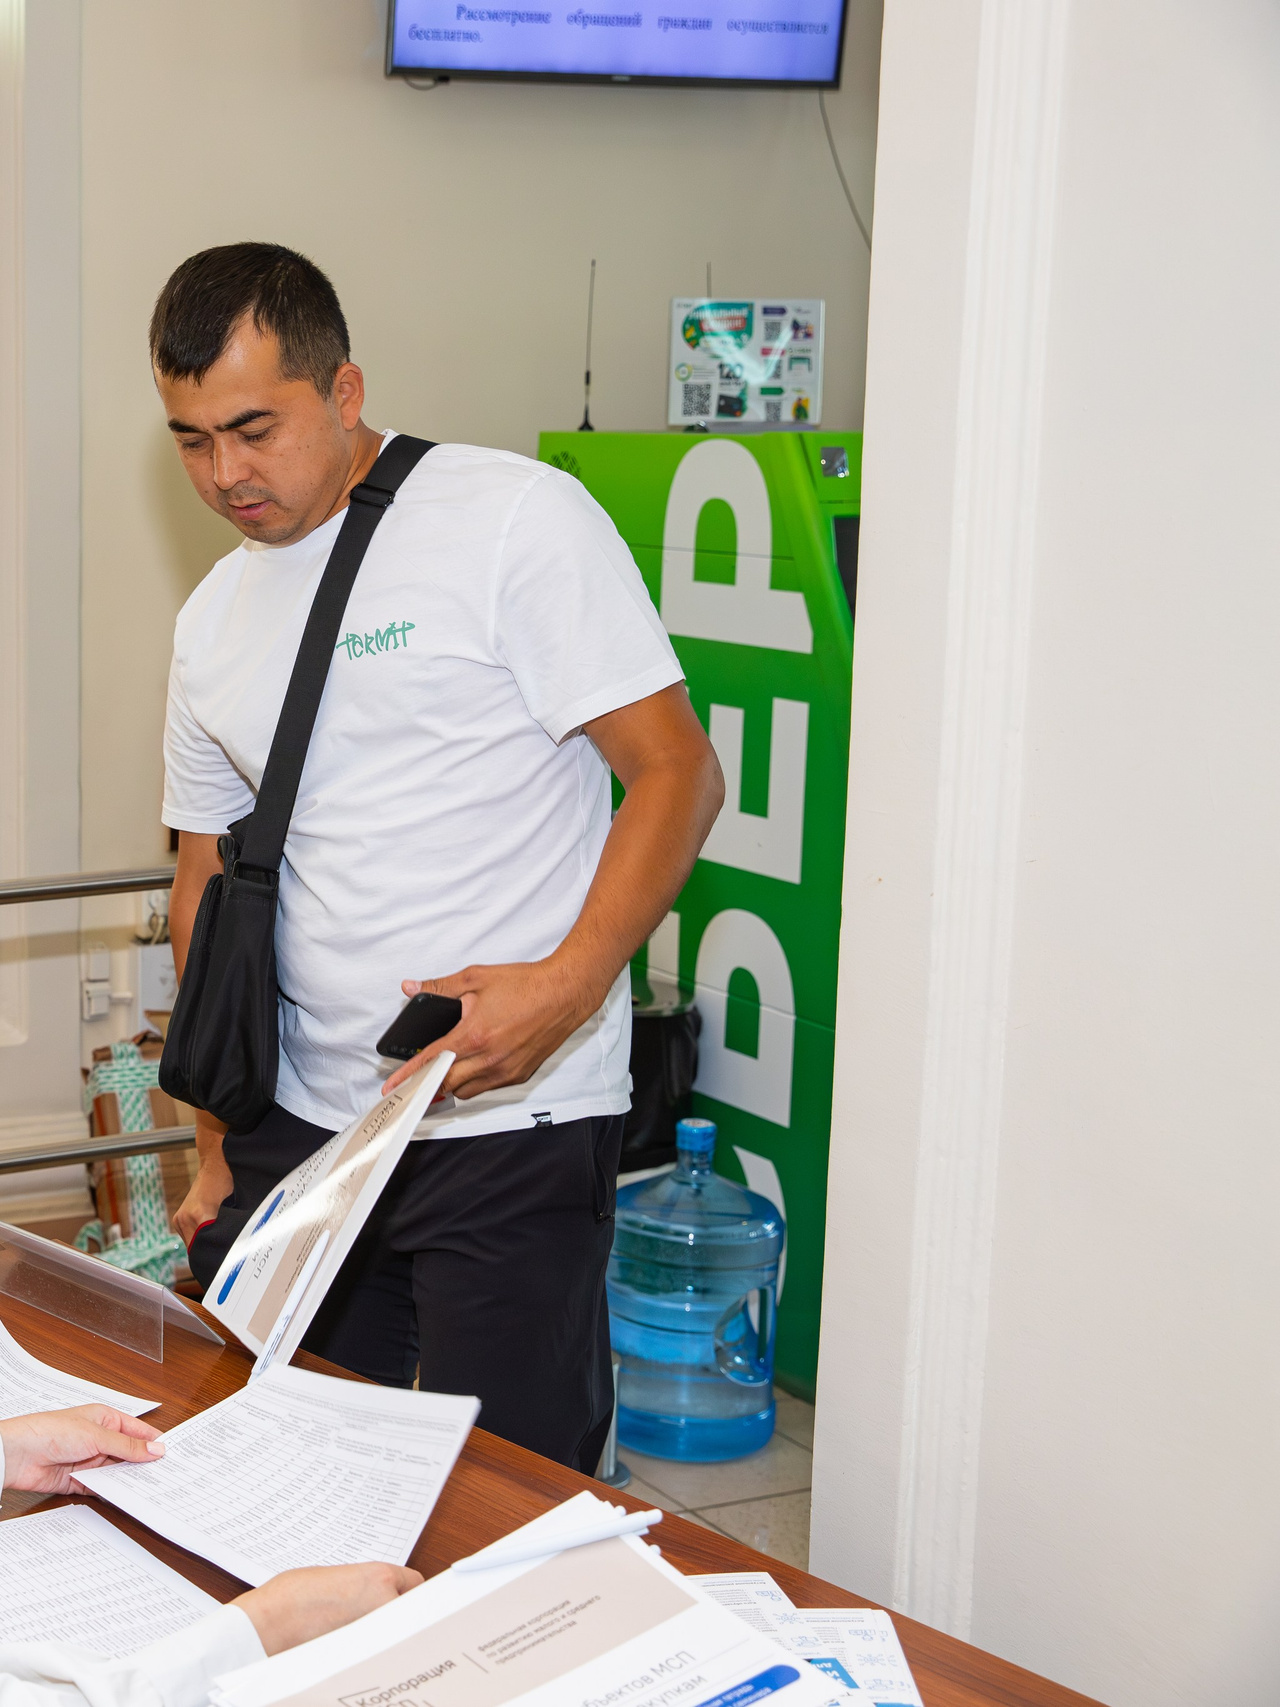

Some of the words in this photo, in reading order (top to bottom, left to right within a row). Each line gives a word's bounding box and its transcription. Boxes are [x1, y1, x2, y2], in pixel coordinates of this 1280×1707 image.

[456, 4, 552, 26] Рассмотрение
[566, 8, 643, 29] обращений
[657, 15, 713, 33] граждан
[354, 1659, 457, 1707] Корпорация
[583, 1674, 655, 1707] бъектов
[649, 1650, 697, 1679] МСП
[635, 1674, 708, 1707] купкам
